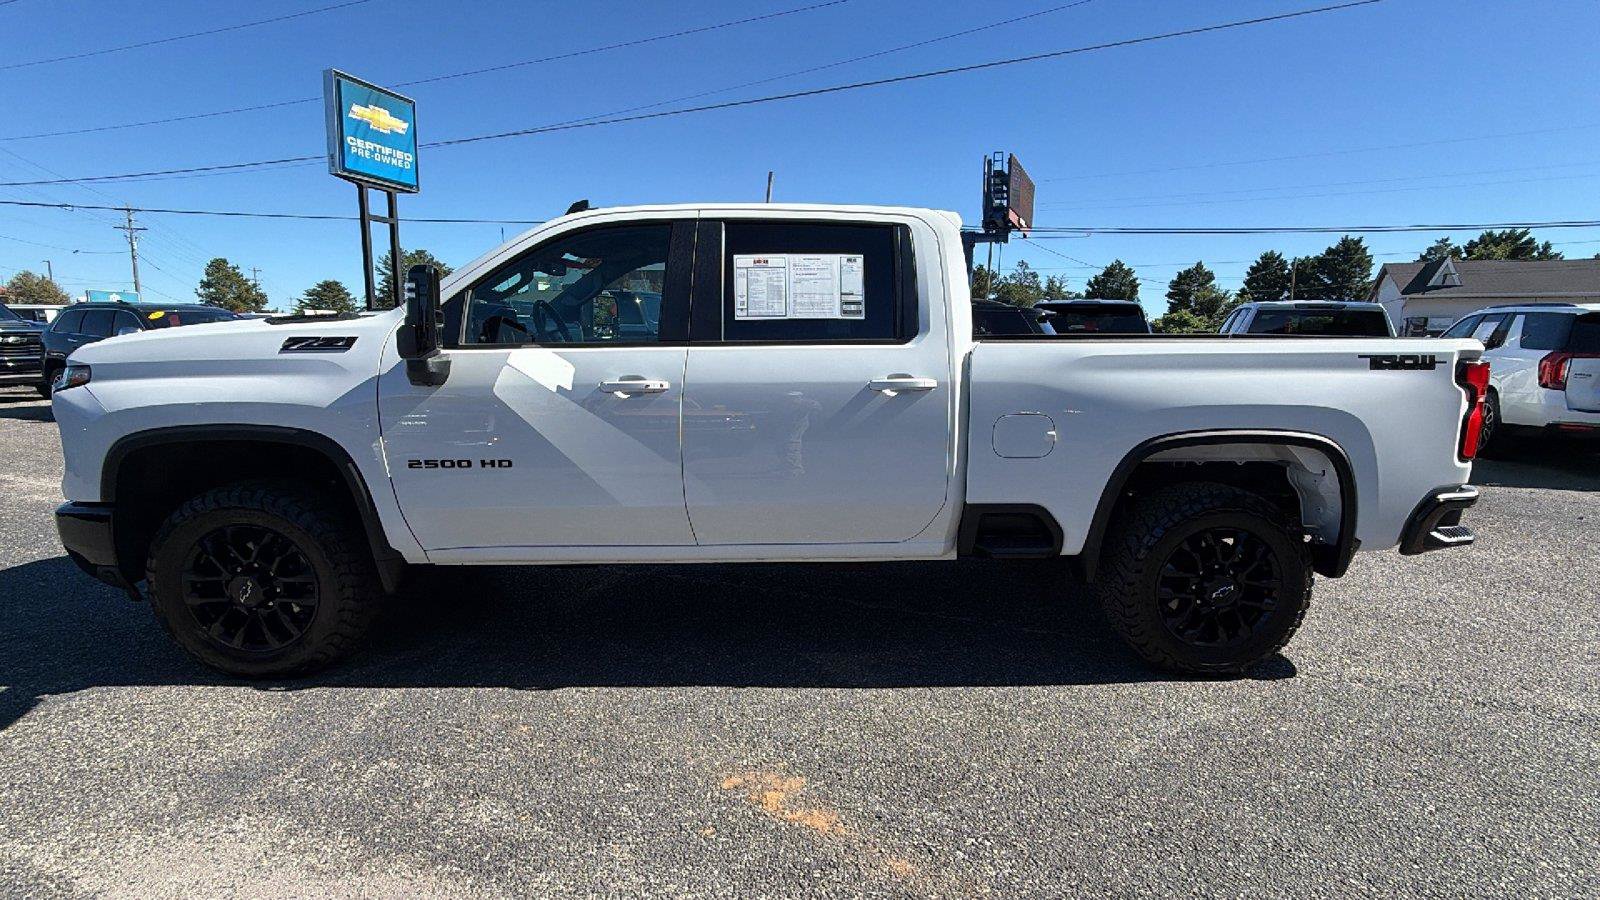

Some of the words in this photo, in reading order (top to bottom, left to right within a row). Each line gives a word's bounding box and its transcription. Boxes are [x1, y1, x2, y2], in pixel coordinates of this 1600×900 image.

[347, 136, 412, 162] CERTIFIED
[351, 146, 411, 169] PRE-OWNED
[407, 459, 473, 469] 2500
[480, 459, 513, 469] HD
